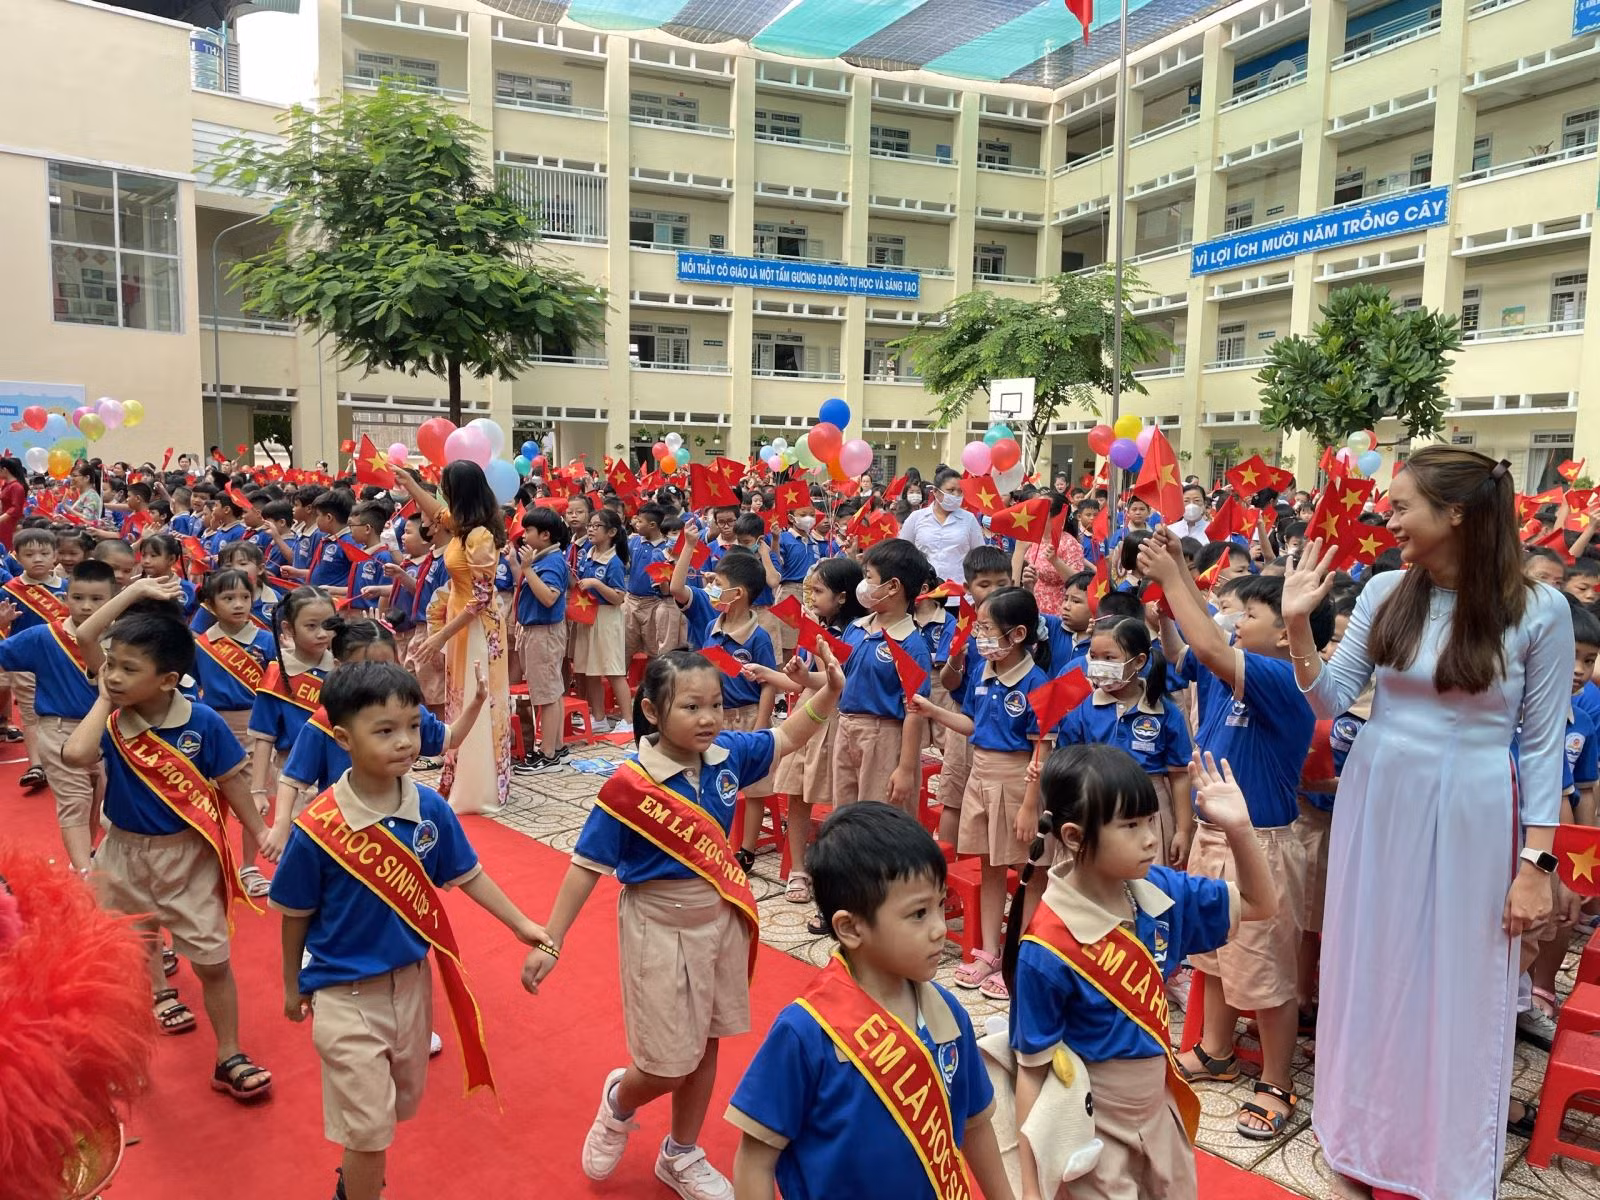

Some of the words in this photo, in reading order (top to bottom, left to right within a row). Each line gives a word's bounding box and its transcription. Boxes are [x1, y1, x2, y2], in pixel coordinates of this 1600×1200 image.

[1195, 250, 1208, 267] VÌ
[1210, 247, 1231, 266] LỢI
[1234, 242, 1258, 259] ÍCH
[1261, 231, 1299, 254] MƯỜI
[1302, 223, 1339, 244] NĂM
[1342, 209, 1400, 235] TRỒNG
[1404, 199, 1444, 222] CÂY
[681, 257, 696, 274] MỖI
[716, 262, 729, 277] CÔ
[729, 263, 749, 279] GIÁO
[749, 265, 759, 280] LÀ
[759, 266, 775, 284] MỘT
[776, 266, 790, 283] TẤM
[791, 270, 817, 285] GƯƠNG
[817, 273, 833, 289] ĐẠO
[834, 272, 849, 287] ĐỨC
[849, 275, 859, 292] TỰ
[858, 277, 874, 292] HỌC
[874, 276, 884, 290] VÀ
[884, 277, 903, 291] SÁNG
[903, 281, 917, 295] TẠO
[211, 642, 233, 658] EM
[296, 682, 321, 704] EM
[133, 743, 162, 768] LÀ
[157, 761, 193, 793] HỌC
[637, 794, 672, 825] EM
[667, 815, 697, 843] LÀ
[331, 821, 382, 865] HỌC
[375, 855, 419, 902] SINH
[432, 909, 439, 930] 1
[1120, 960, 1152, 1005] LÀ
[1149, 984, 1169, 1031] HỌ
[853, 1013, 907, 1075] EM
[892, 1063, 932, 1122] LÀ
[921, 1105, 952, 1183] HỌC
